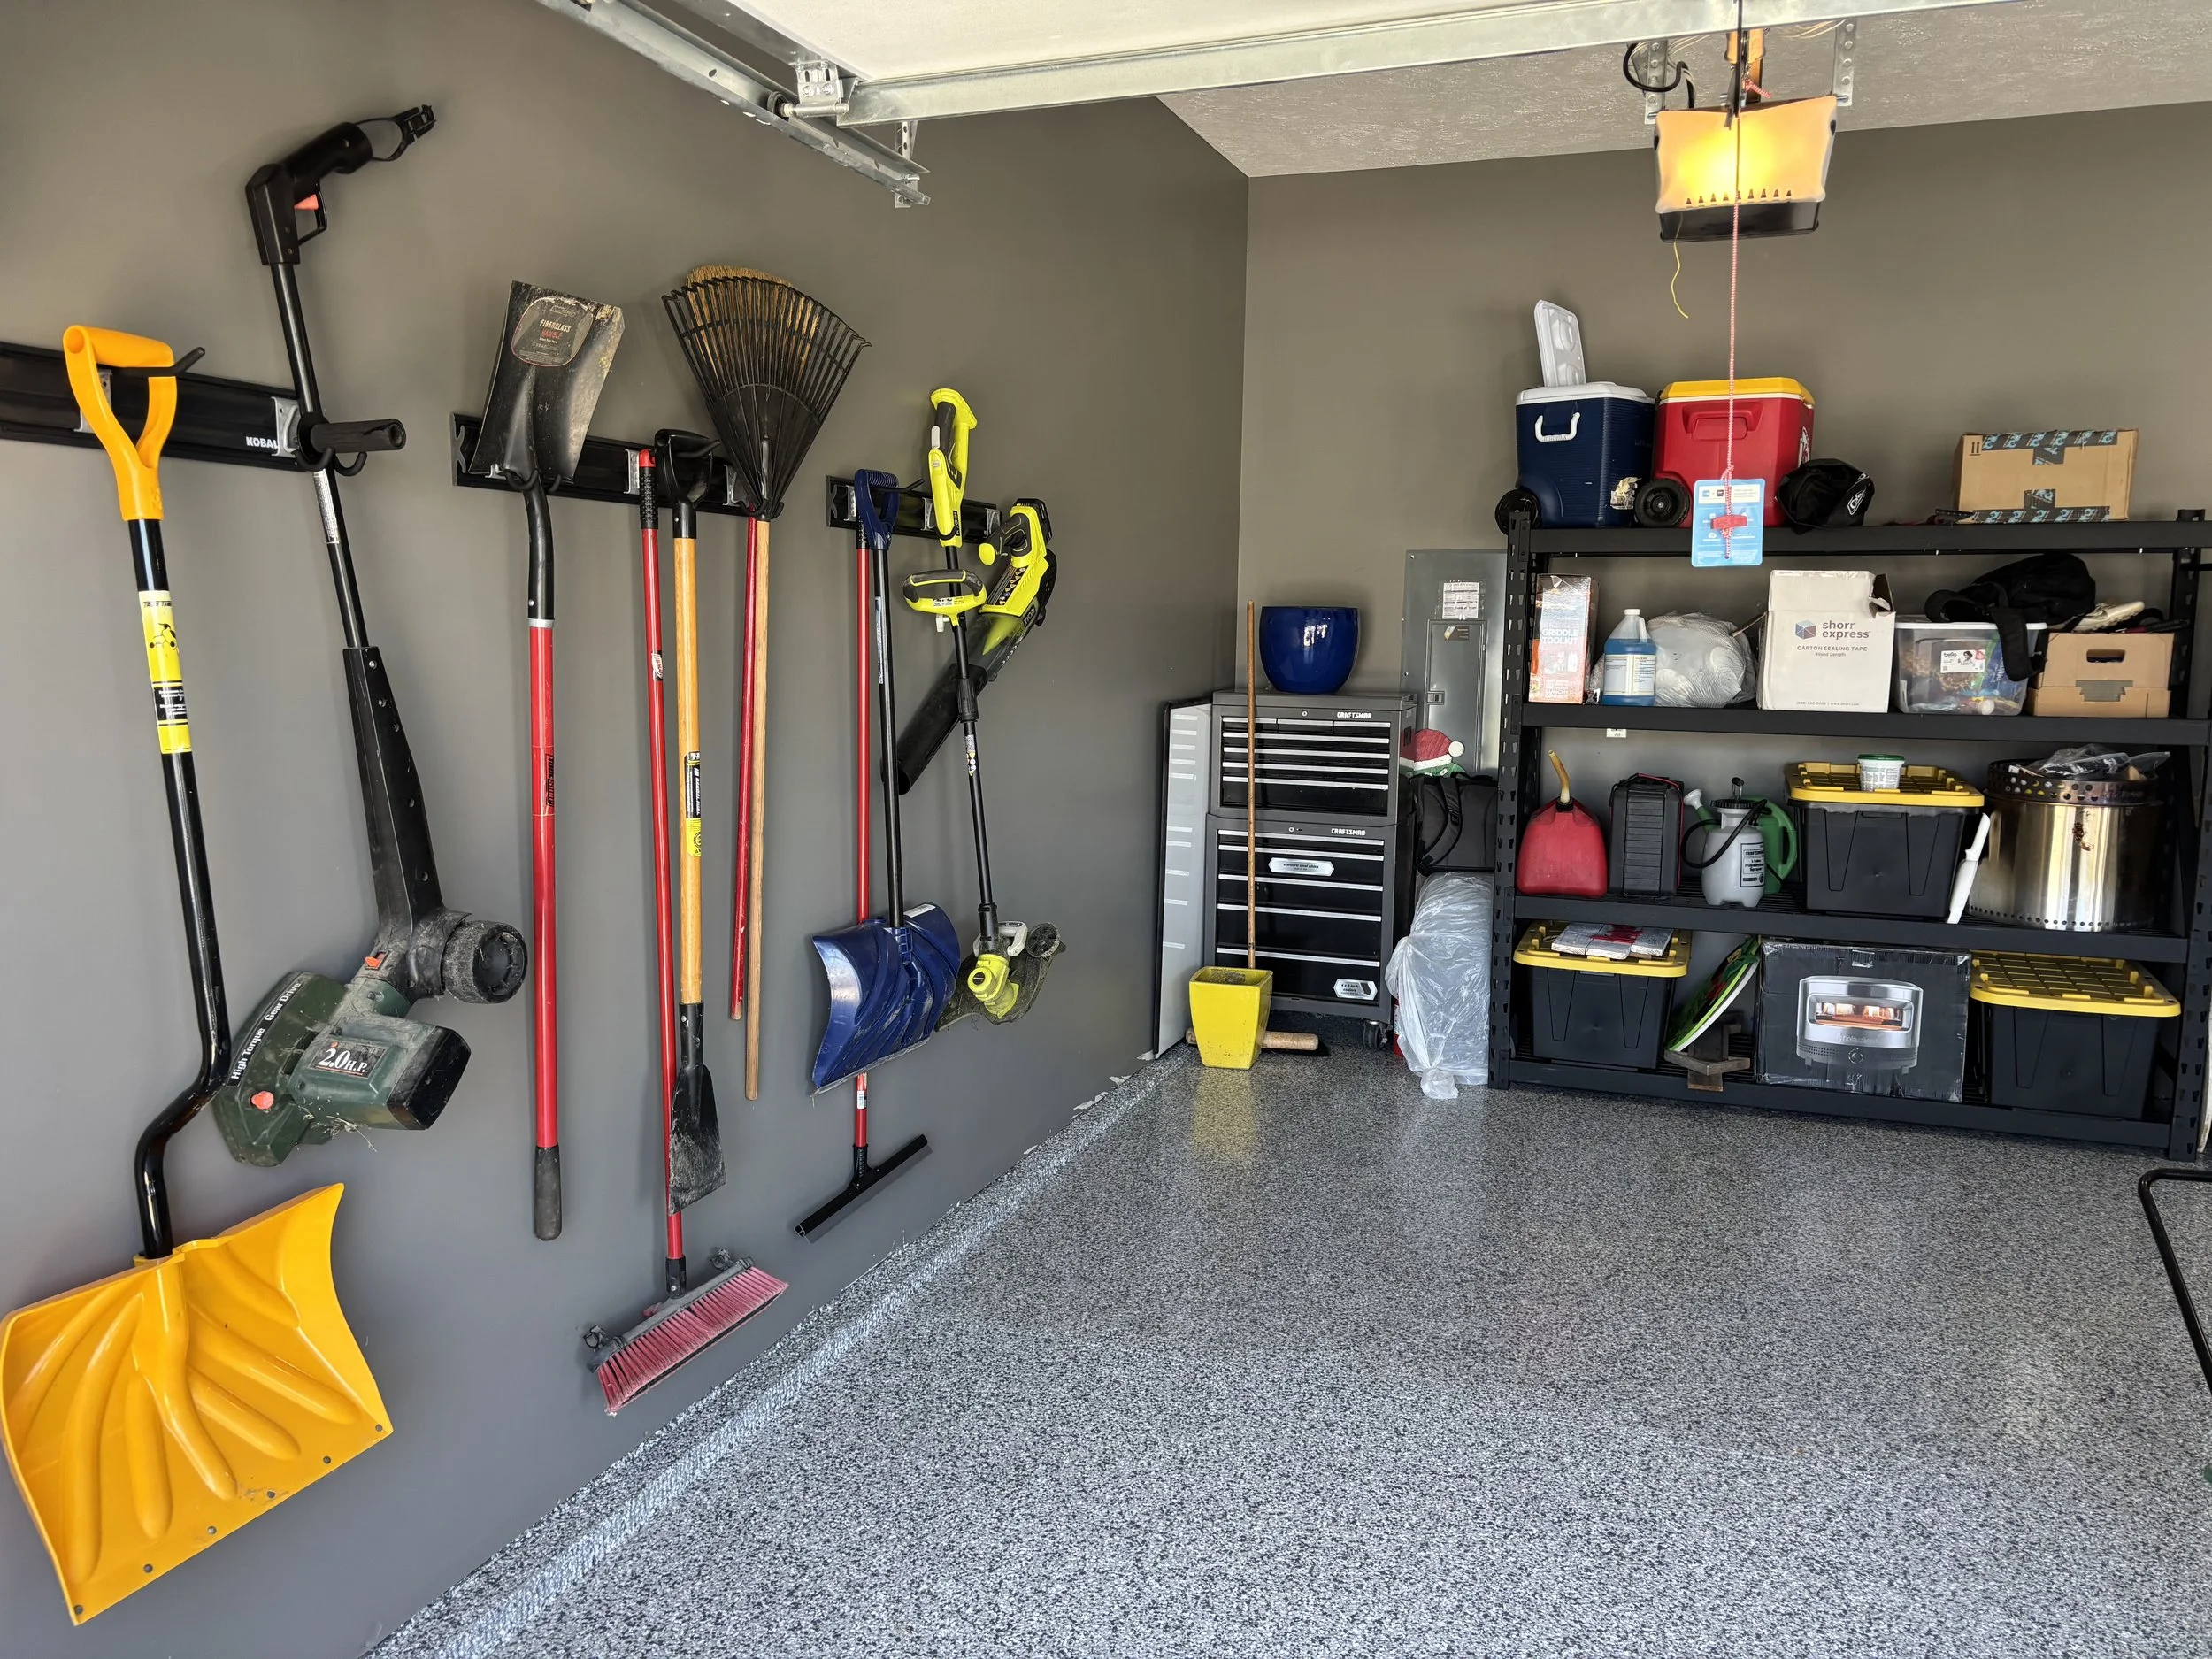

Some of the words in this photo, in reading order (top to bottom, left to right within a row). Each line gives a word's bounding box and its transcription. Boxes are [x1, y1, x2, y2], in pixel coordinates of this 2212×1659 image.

[539, 319, 572, 333] FIBERGLASS
[245, 436, 279, 449] KOBAL
[1823, 620, 1855, 630] shorr
[1542, 628, 1579, 637] GRIDDLE
[1822, 631, 1870, 640] express
[231, 1057, 248, 1079] High
[242, 1027, 265, 1056] Torque
[265, 1002, 284, 1021] Gear
[279, 982, 302, 1002] Drive
[317, 1048, 351, 1069] 2.0
